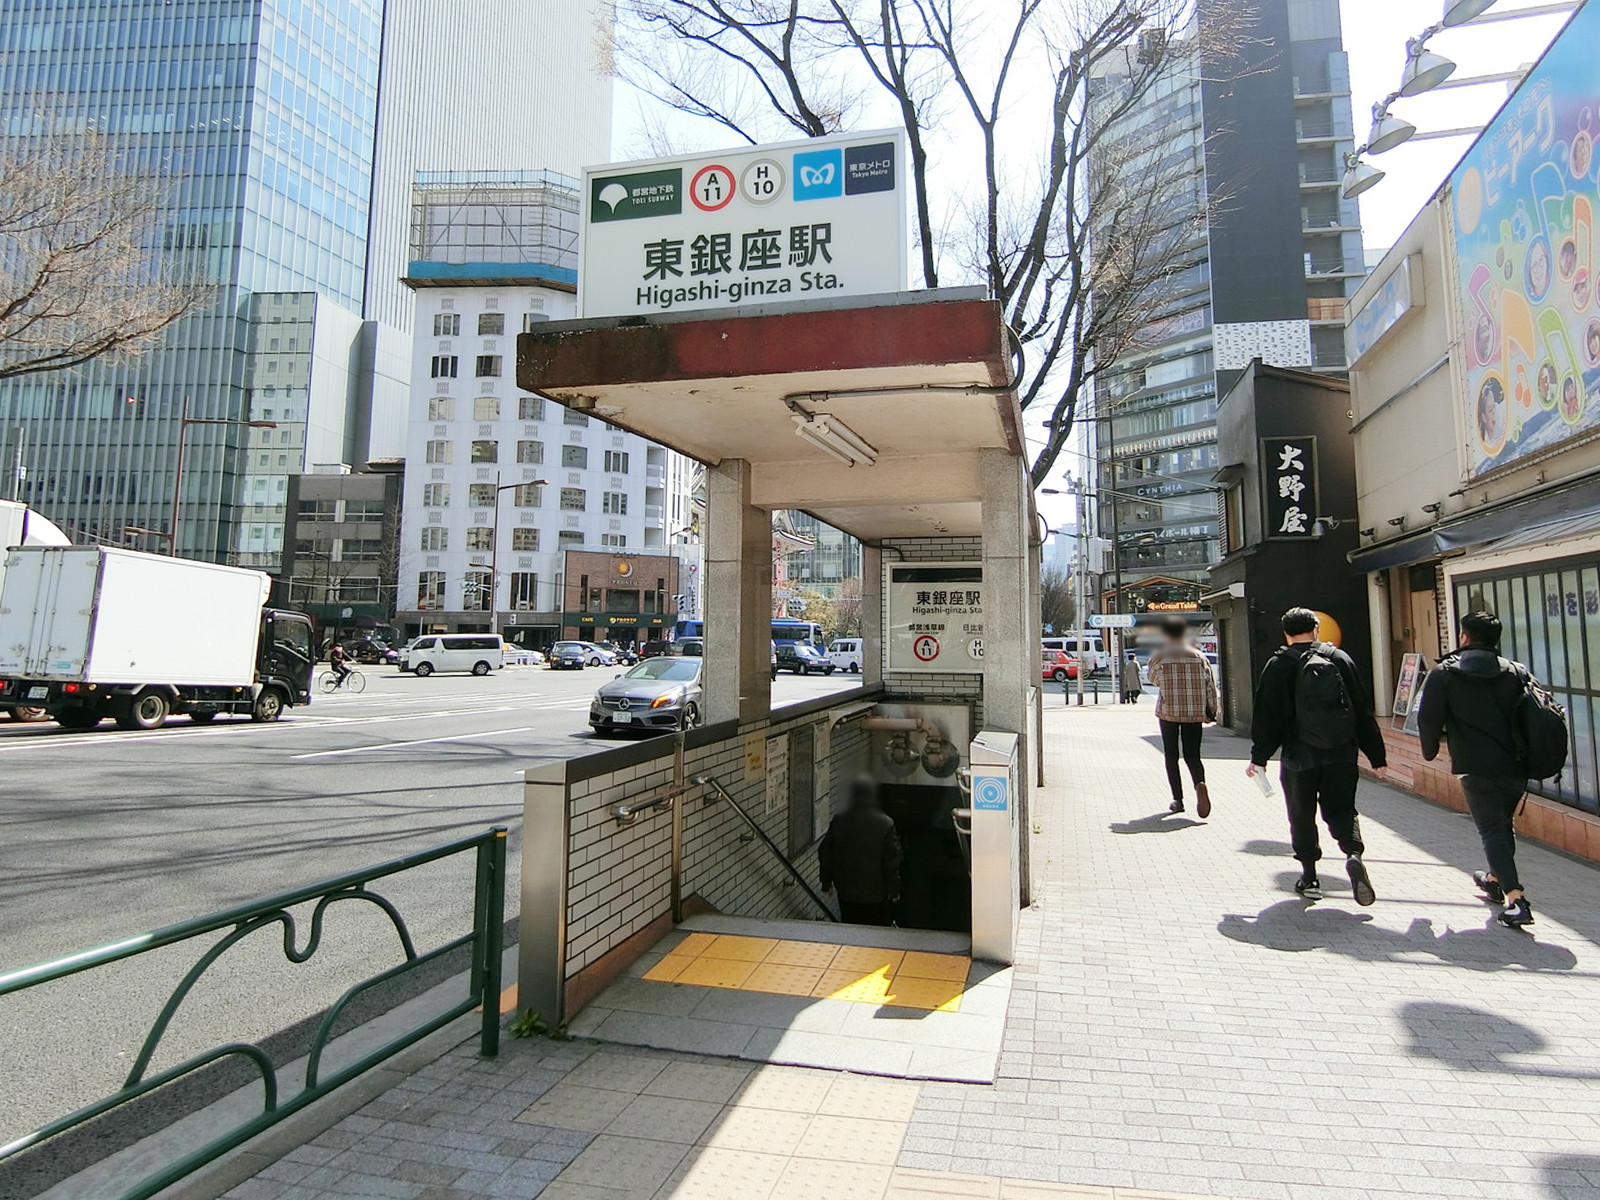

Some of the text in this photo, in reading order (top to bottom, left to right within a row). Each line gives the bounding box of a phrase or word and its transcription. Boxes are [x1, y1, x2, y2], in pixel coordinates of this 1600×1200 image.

[849, 159, 891, 172] 東京メトロ
[757, 166, 768, 179] H
[852, 169, 888, 179] Tokyo Metro
[707, 173, 719, 186] A
[632, 184, 675, 197] 都営地下鉄
[753, 181, 774, 195] 10
[704, 189, 721, 202] 11
[643, 223, 832, 280] 東銀座駅
[636, 271, 845, 309] Higashi-ginza Sta.
[1137, 484, 1183, 496] CYNTHIA
[1277, 444, 1308, 533] 大野屋
[916, 591, 980, 605] 東銀座駅
[912, 606, 967, 615] Higashi-ginza
[974, 640, 982, 648] H
[921, 648, 932, 656] 11
